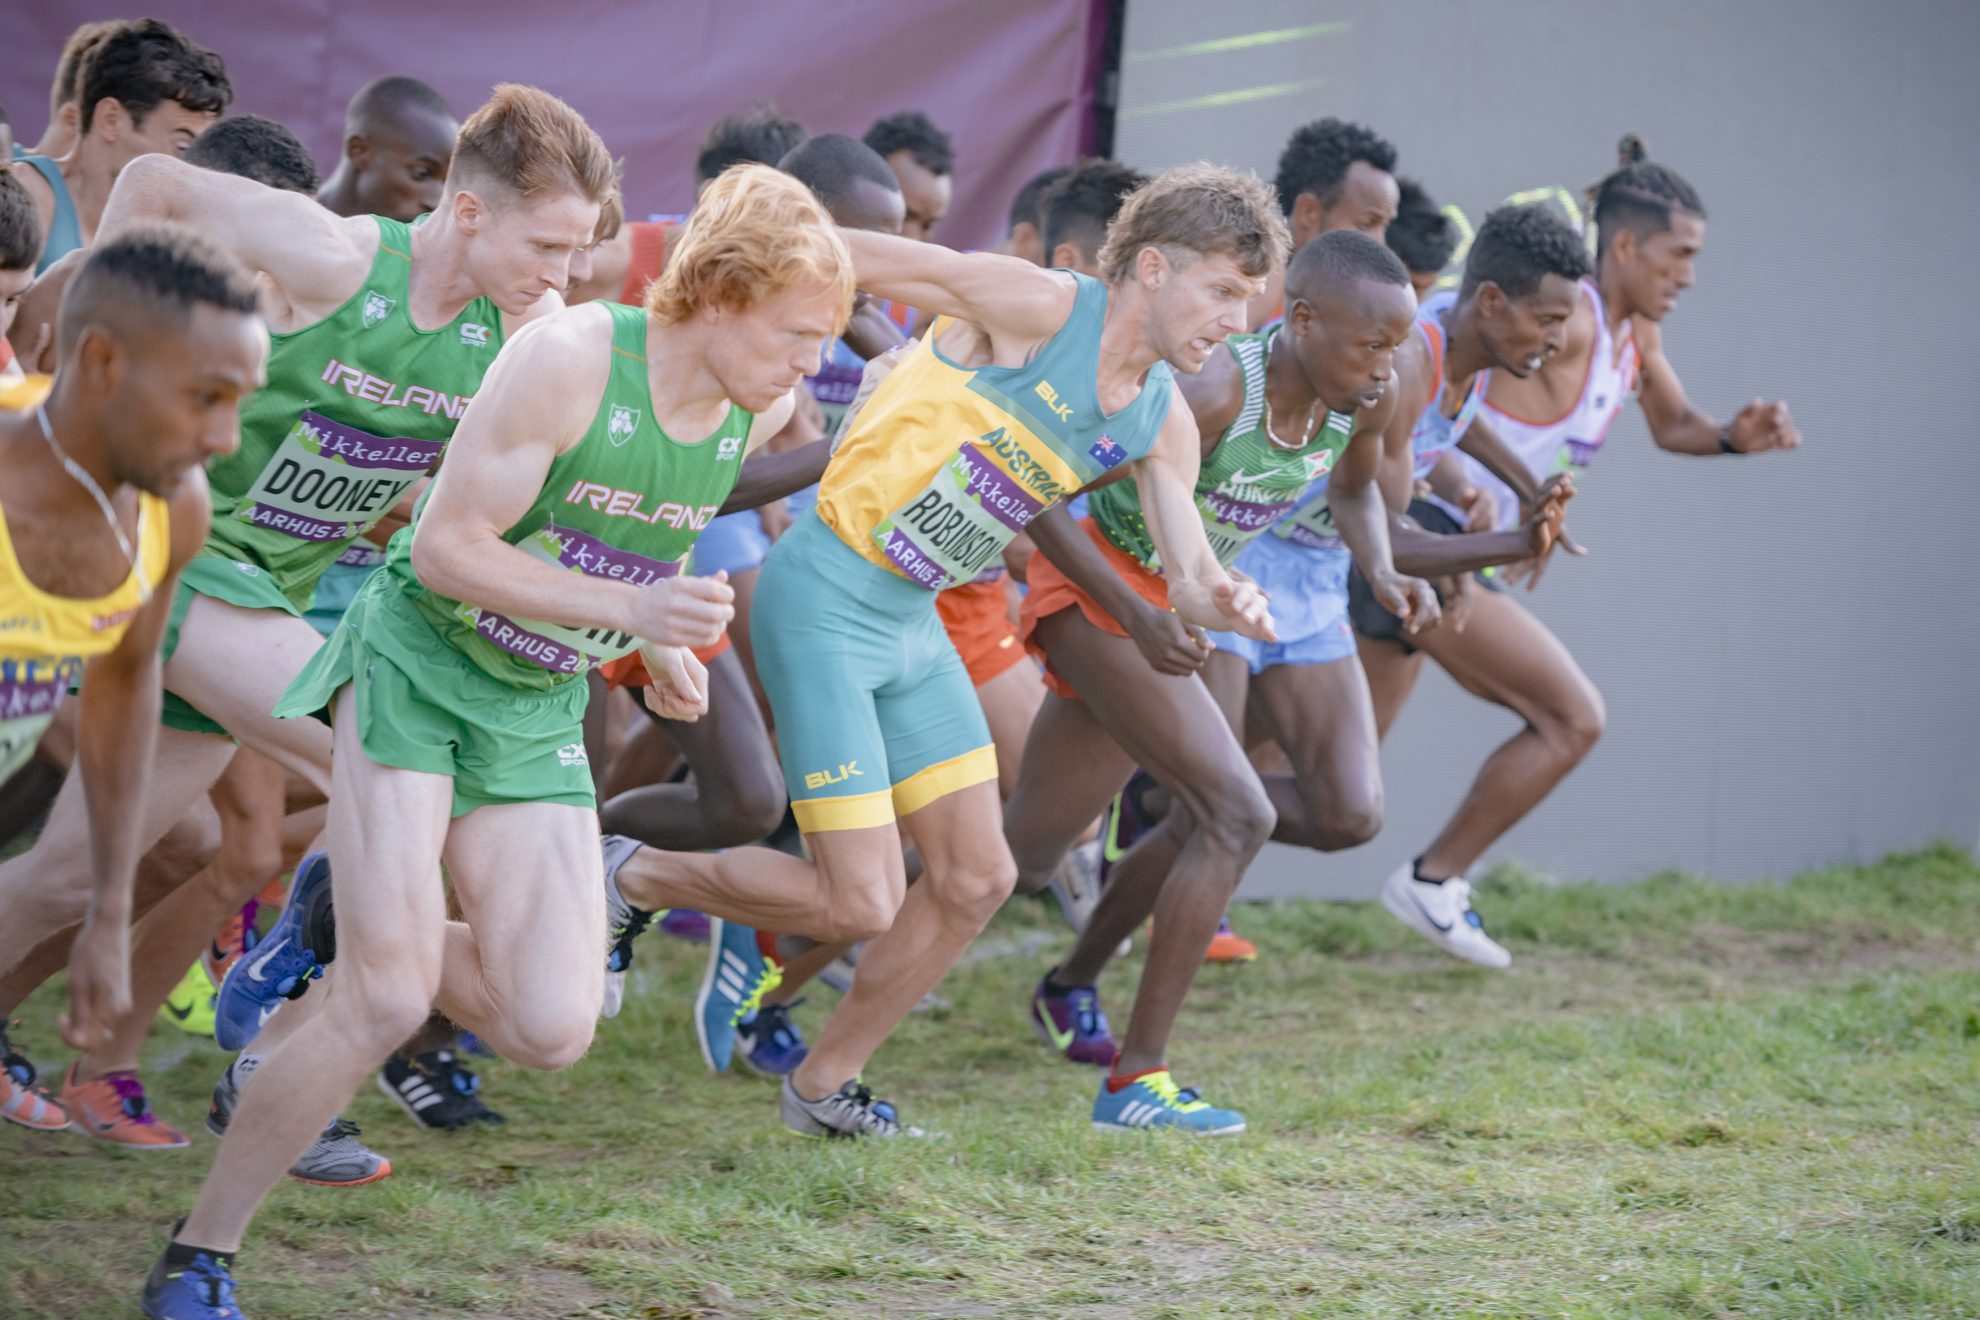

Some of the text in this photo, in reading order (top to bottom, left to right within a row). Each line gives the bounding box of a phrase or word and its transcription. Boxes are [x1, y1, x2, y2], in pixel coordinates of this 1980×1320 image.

[1034, 380, 1074, 423] BLK
[295, 421, 437, 464] Mikkeller
[262, 458, 413, 513] DOONEY
[565, 480, 718, 530] IRELAND
[952, 452, 1033, 526] Mikkeller
[239, 505, 332, 539] AARHUS
[902, 490, 1004, 574] ROBINSON
[539, 529, 669, 588] Mikkell
[879, 528, 937, 580] AARHUS
[464, 604, 560, 663] AARHUS
[804, 760, 865, 790] BLK
